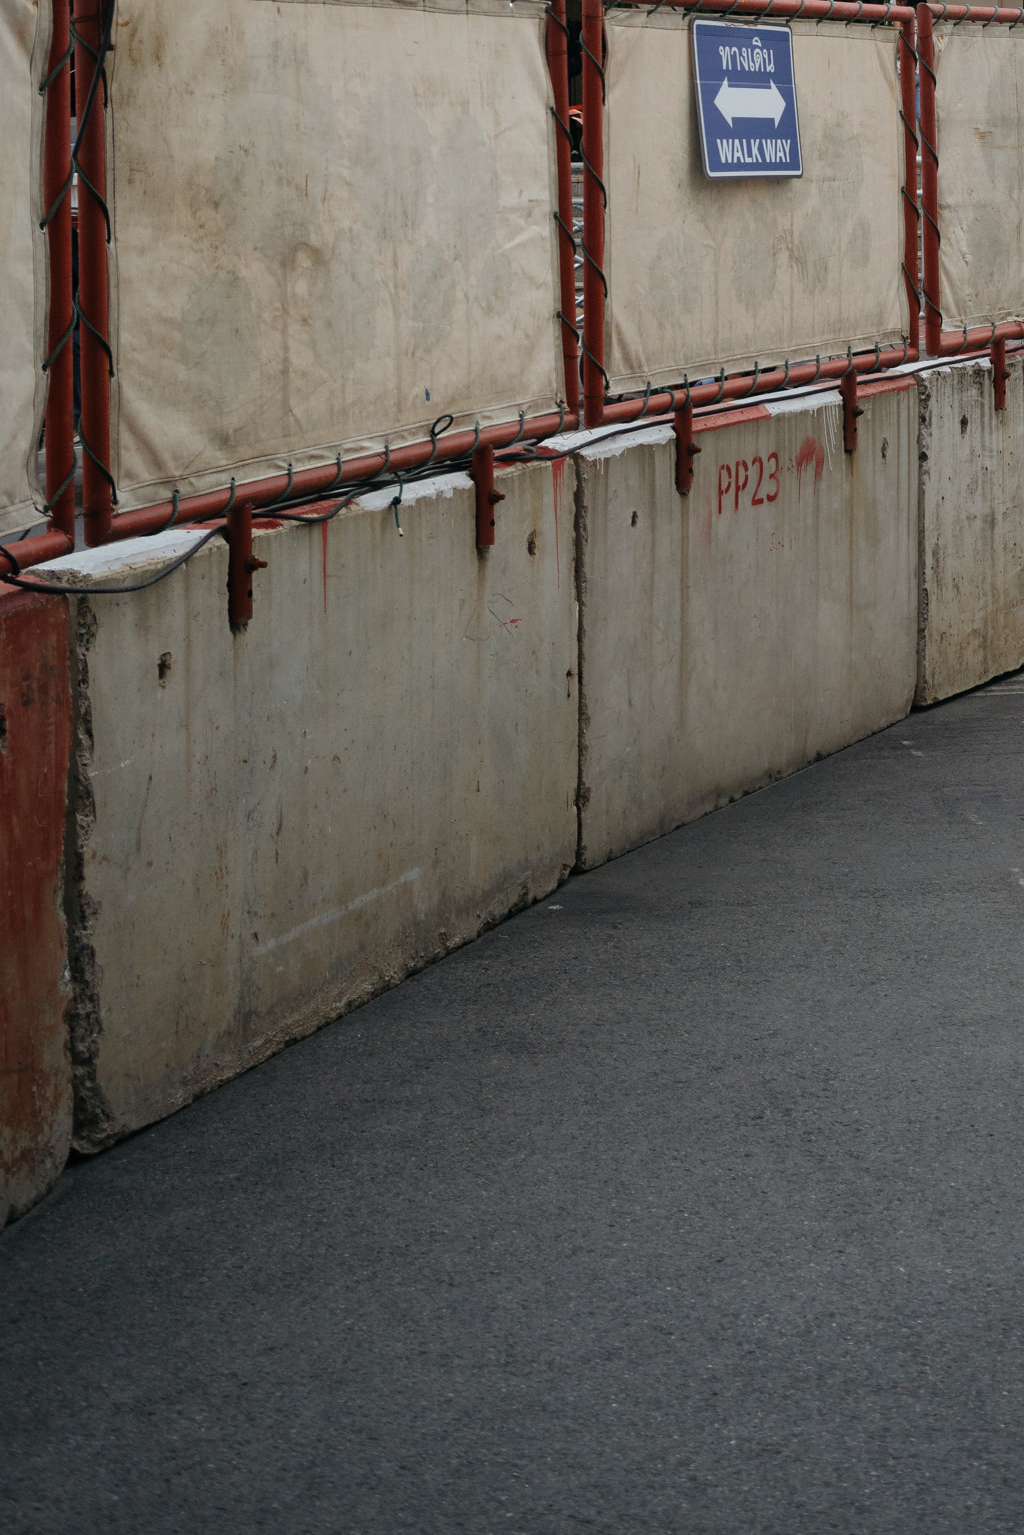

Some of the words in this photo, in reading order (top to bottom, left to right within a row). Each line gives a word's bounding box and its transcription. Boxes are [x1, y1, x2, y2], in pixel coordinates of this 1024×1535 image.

[719, 36, 775, 73] ทางเดิน
[718, 452, 780, 514] PP23
